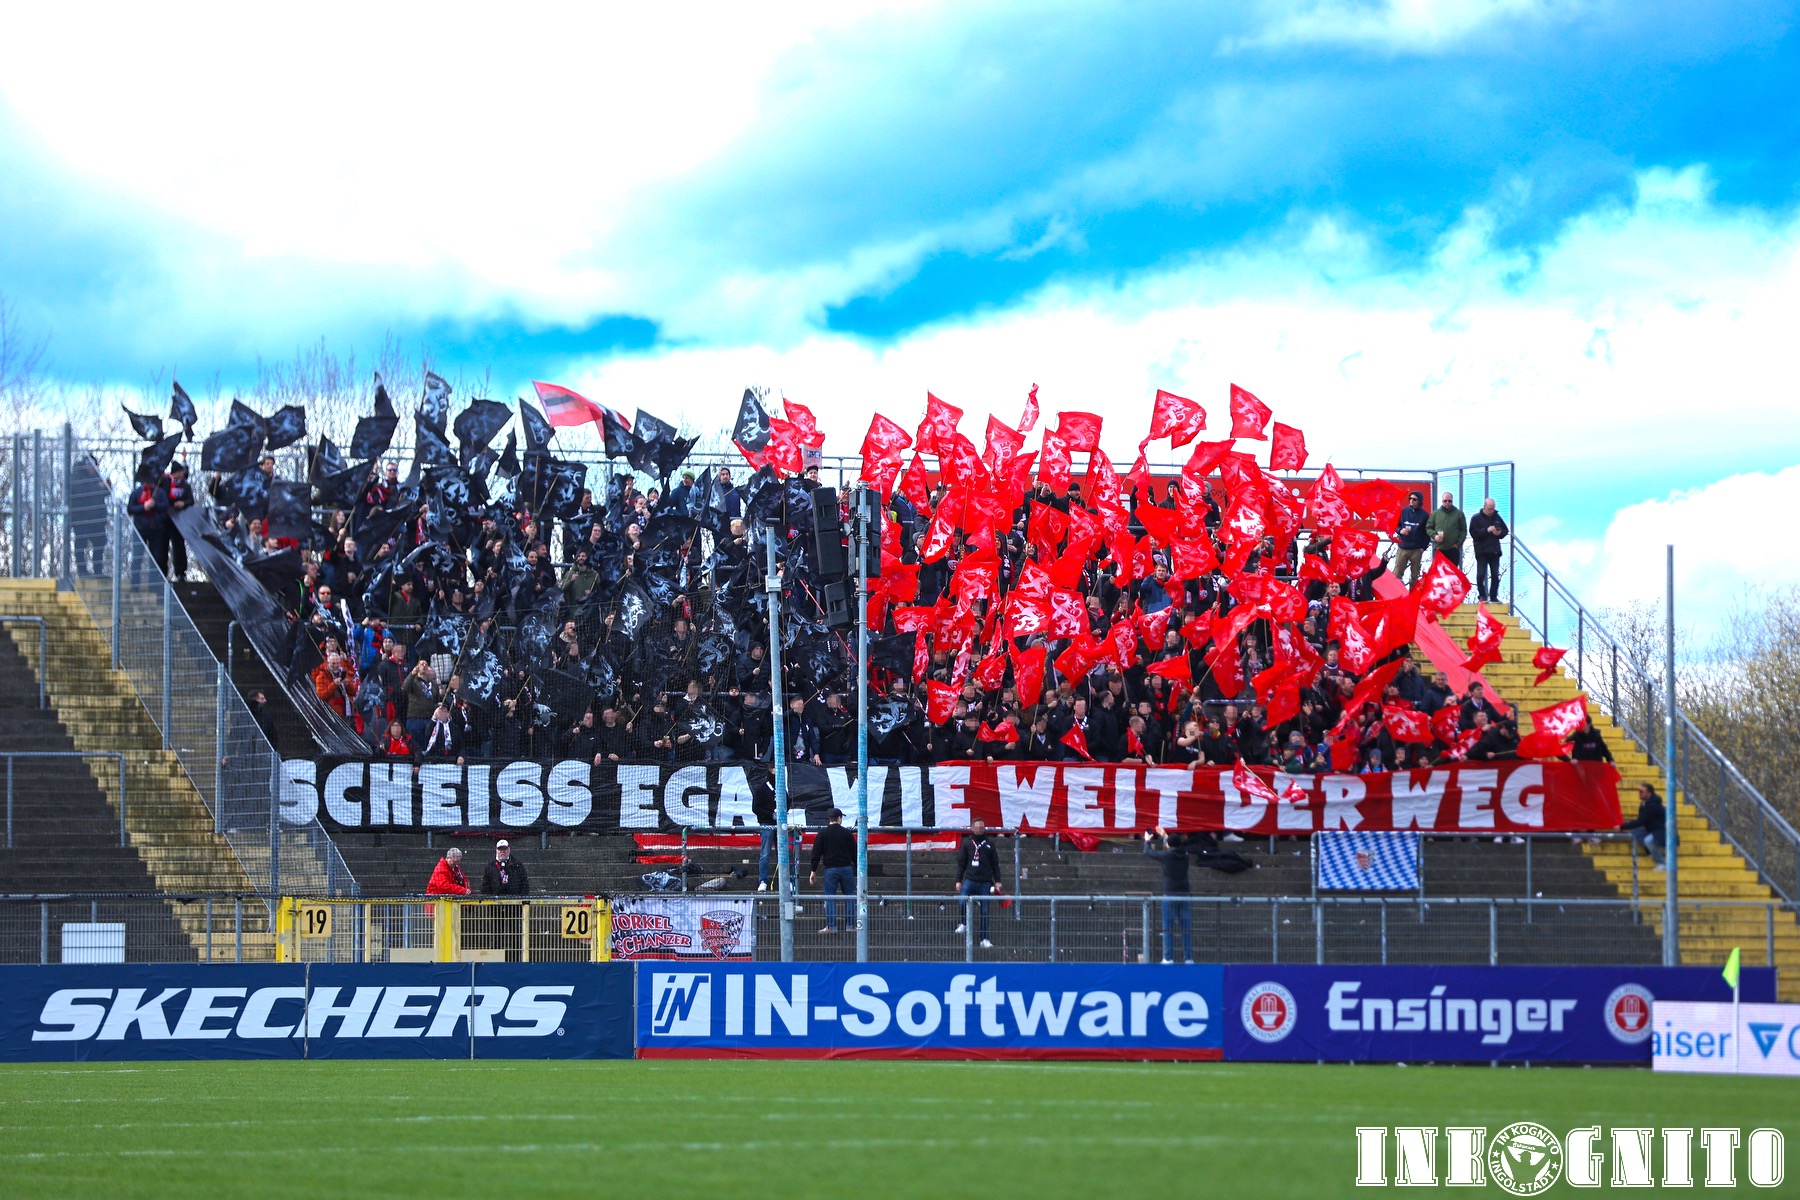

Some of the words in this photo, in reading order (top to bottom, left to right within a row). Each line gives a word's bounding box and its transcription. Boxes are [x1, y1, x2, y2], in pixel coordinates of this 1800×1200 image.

[270, 758, 593, 828] SCHEISS
[826, 765, 971, 828] WIE
[997, 765, 1194, 829] WEIT
[1219, 774, 1366, 832] DER
[1391, 764, 1545, 828] WEG
[306, 910, 327, 934] 19
[566, 911, 588, 935] 20
[615, 933, 692, 959] SCHANZER
[725, 974, 1208, 1037] IN-Software
[1324, 981, 1578, 1044] Ensinger
